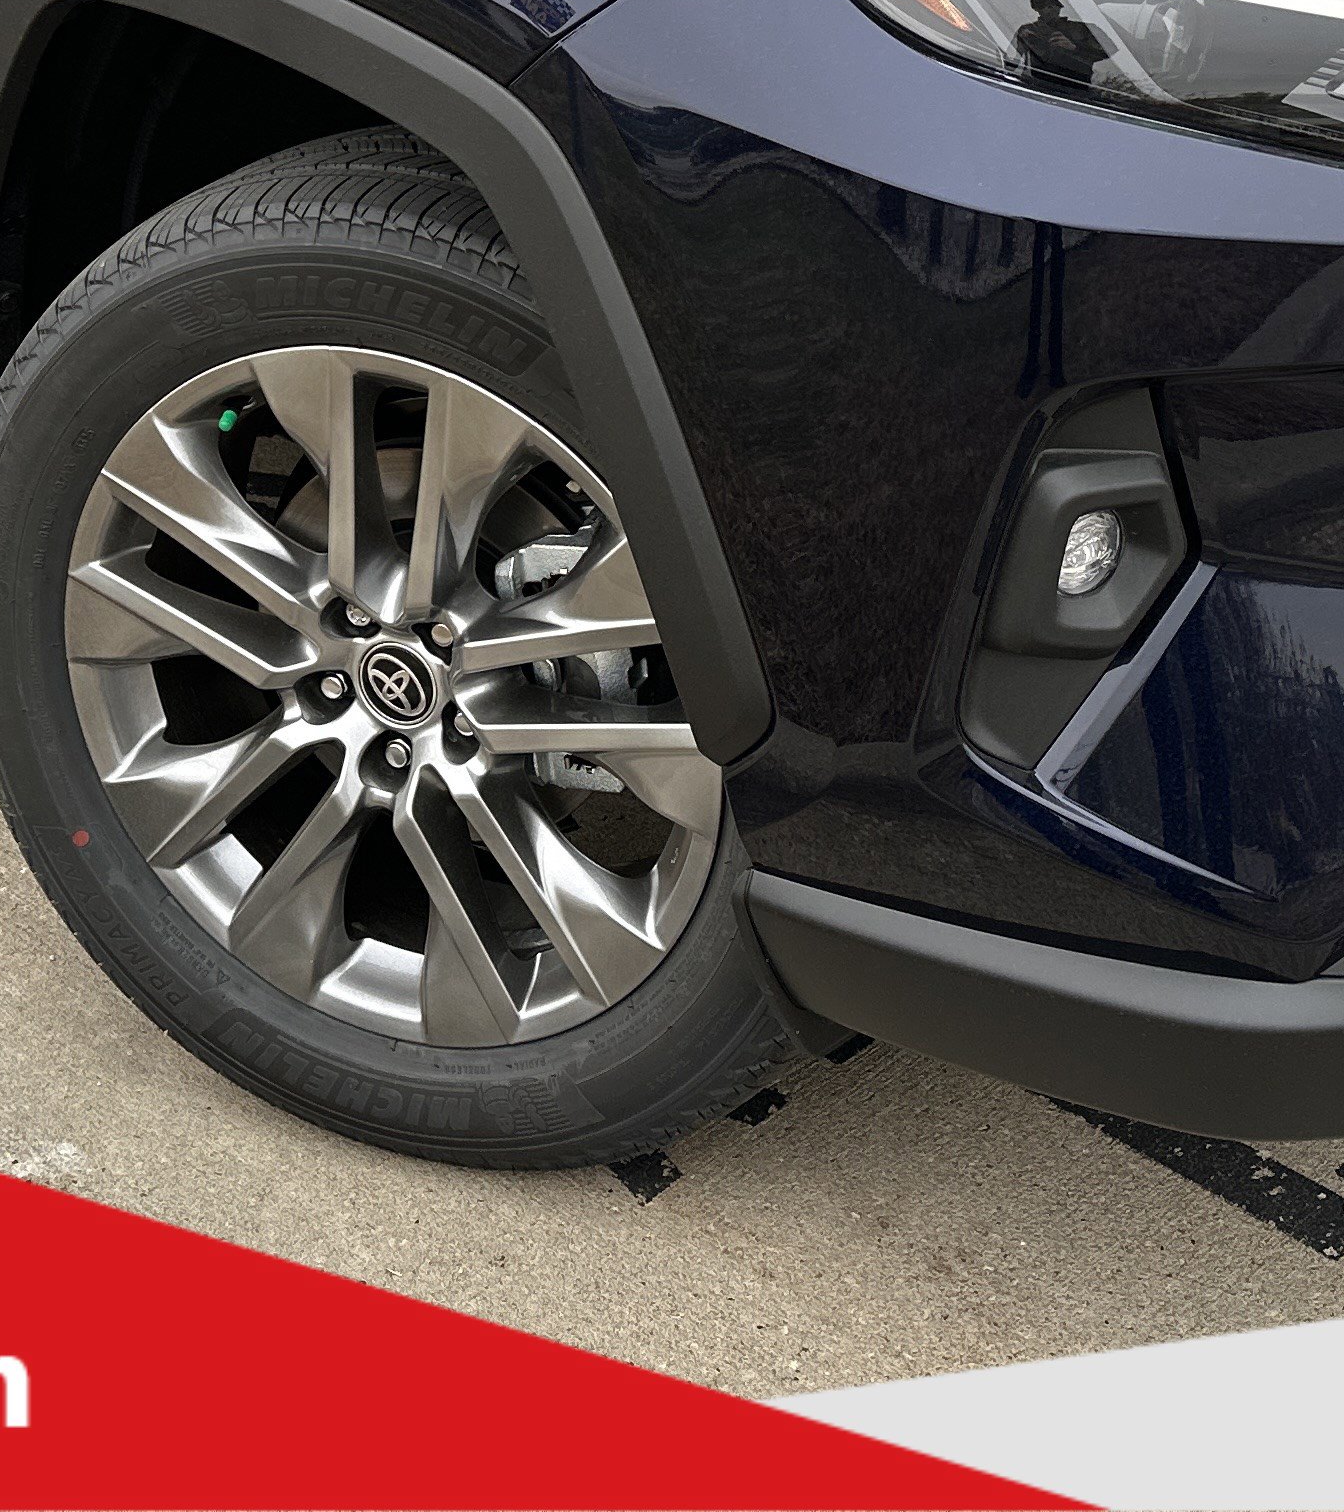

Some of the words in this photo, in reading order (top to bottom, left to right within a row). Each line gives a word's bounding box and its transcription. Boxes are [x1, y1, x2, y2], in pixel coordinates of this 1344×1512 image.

[257, 274, 529, 367] MICHELIN
[76, 884, 190, 1007] PRIMACY
[216, 1020, 473, 1130] MICHELIN
